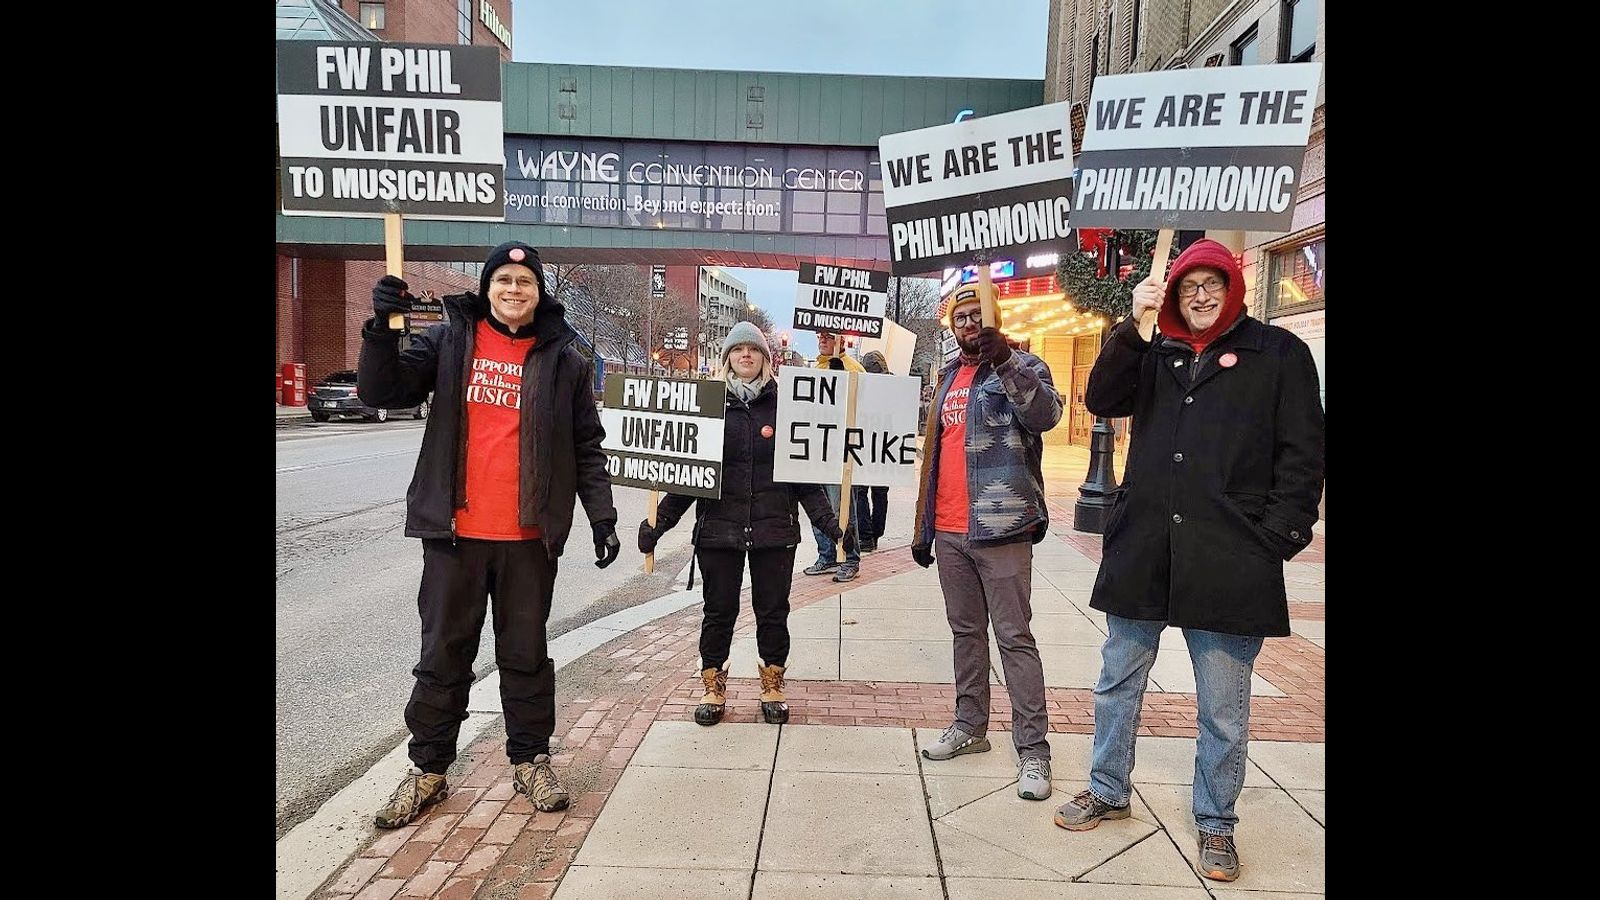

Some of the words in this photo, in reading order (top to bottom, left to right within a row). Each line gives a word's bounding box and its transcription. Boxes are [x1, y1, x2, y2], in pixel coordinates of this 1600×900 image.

[479, 0, 512, 50] Hilton
[316, 46, 371, 91] FW
[380, 47, 461, 94] PHIL
[319, 105, 462, 155] UNFAIR
[1096, 97, 1146, 131] WE
[1153, 92, 1226, 128] ARE
[1239, 89, 1308, 125] THE
[517, 149, 619, 183] WAYNE
[629, 162, 774, 188] CONVENTION
[782, 168, 865, 192] CENTER
[887, 153, 932, 188] WE
[943, 141, 998, 179] ARE
[1008, 129, 1064, 167] THE
[288, 166, 324, 198] TO
[331, 167, 496, 204] MUSICIANS
[553, 193, 630, 211] convention.
[634, 194, 687, 215] Beyond
[1075, 165, 1295, 214] PHILHARMONIC
[891, 196, 1072, 262] PHILHARMONIC
[814, 265, 838, 285] FW
[840, 268, 872, 290] PHIL
[812, 289, 870, 313] UNFAIR
[797, 311, 812, 326] TO
[813, 313, 880, 334] MUSICIANS
[623, 378, 653, 408] FW
[656, 380, 701, 413] PHIL
[792, 375, 838, 406] ON
[621, 416, 699, 454] UNFAIR
[789, 421, 918, 467] STRIKE
[624, 457, 716, 489] MUSICIANS
